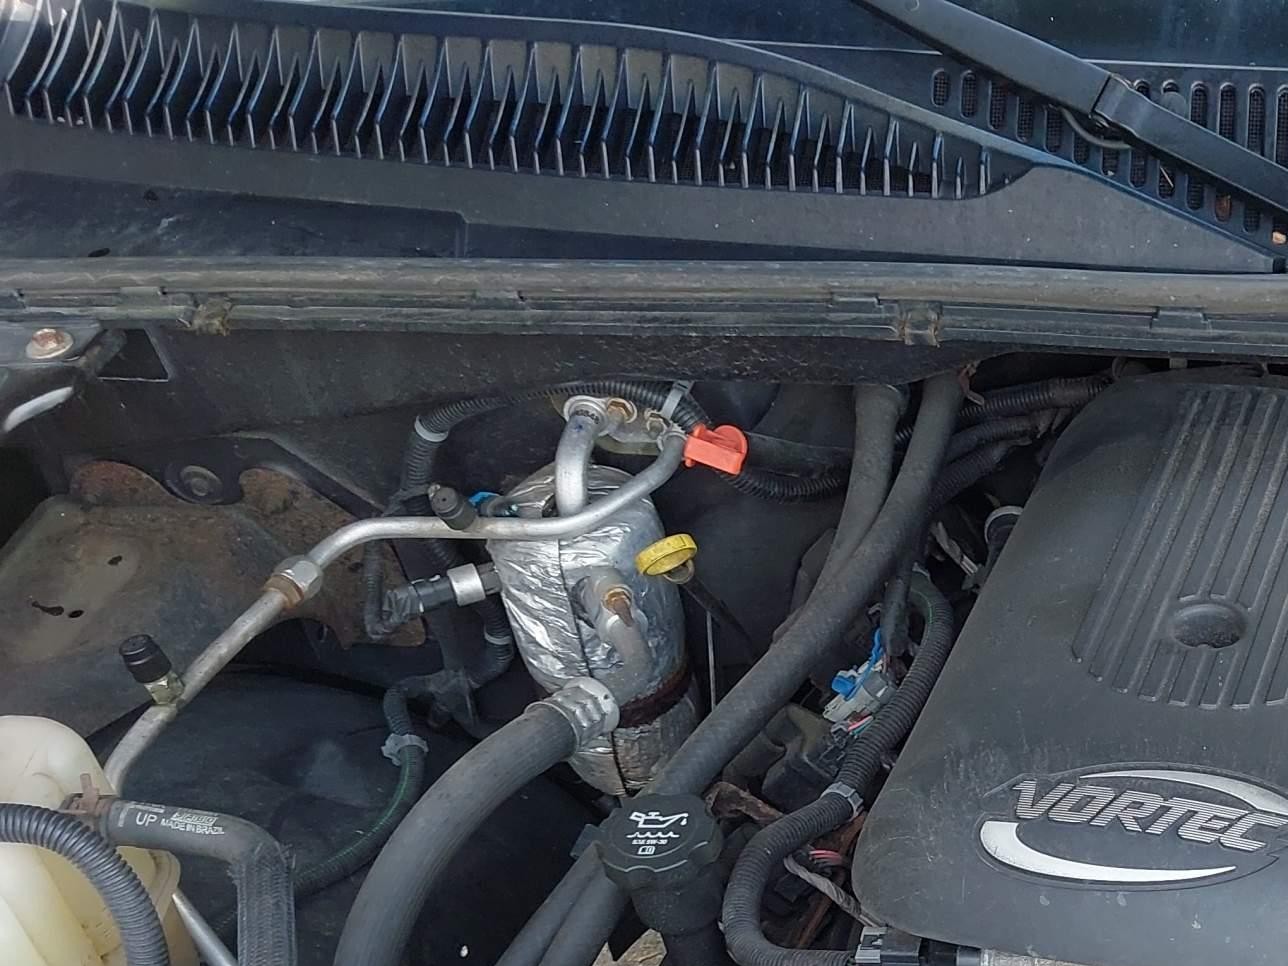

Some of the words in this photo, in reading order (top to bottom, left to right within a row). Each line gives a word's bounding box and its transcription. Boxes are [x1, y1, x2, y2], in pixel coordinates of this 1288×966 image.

[135, 811, 158, 827] UP
[160, 818, 185, 831] MADE
[186, 823, 195, 832] IN
[195, 825, 225, 835] BRAZIL
